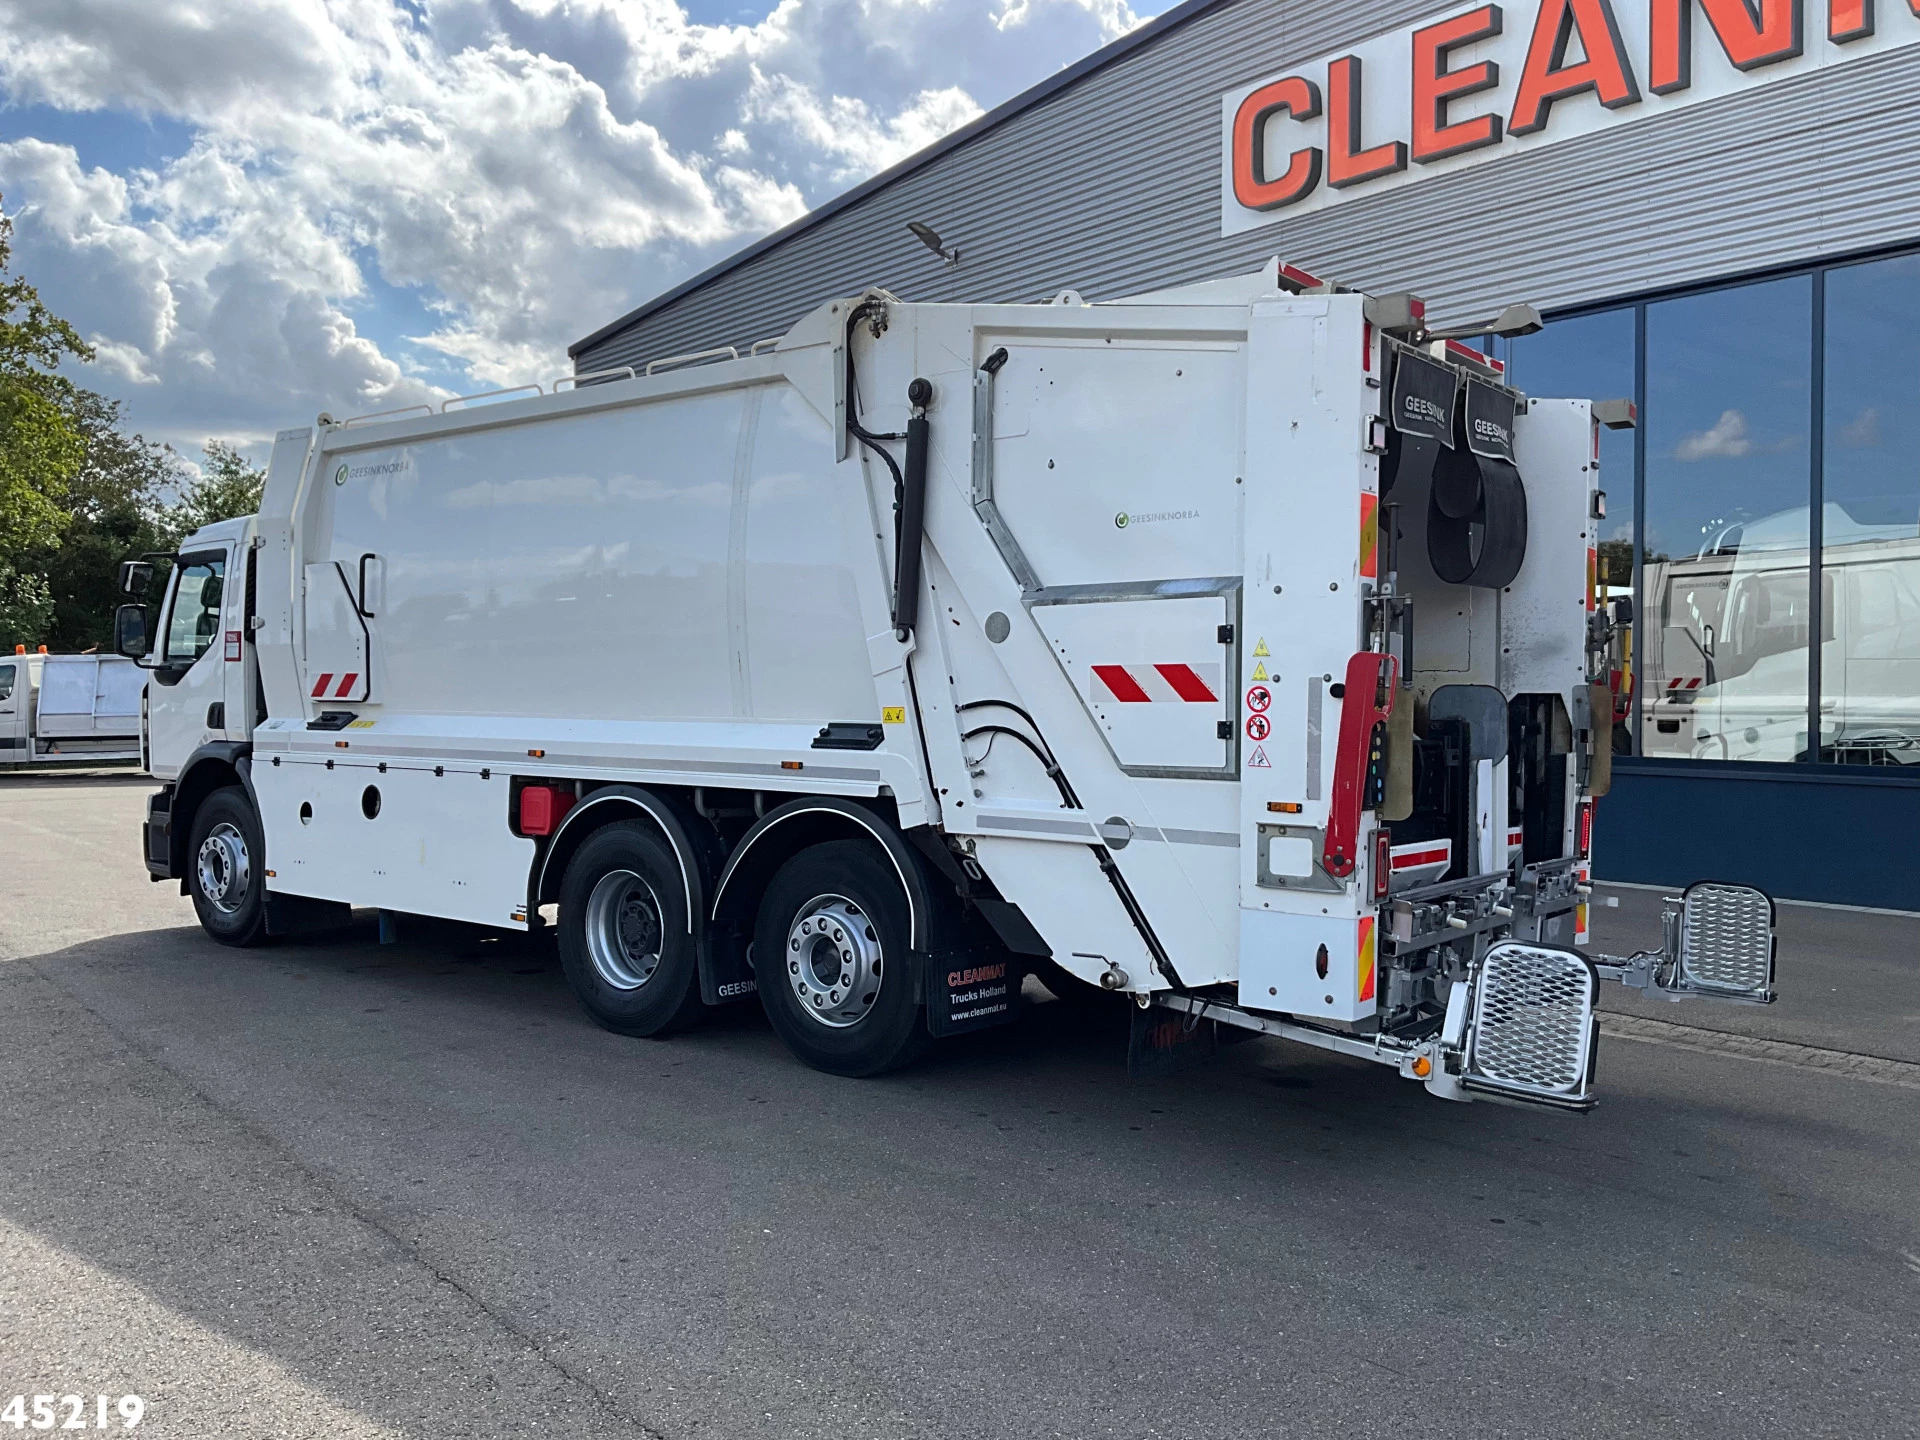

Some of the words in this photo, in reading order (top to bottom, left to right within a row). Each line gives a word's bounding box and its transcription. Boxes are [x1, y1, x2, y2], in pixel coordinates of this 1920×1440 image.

[1232, 0, 1920, 212] CLEAN
[1405, 395, 1445, 423] GEESINK
[1474, 418, 1508, 443] GEESINK
[349, 461, 409, 479] GEESINKNORBA
[1130, 509, 1200, 524] GEESINKNORBA
[948, 963, 1006, 987] CLEANMAT
[718, 980, 757, 997] GEESIN
[950, 991, 978, 1004] Trucks
[979, 984, 1006, 999] Holland
[950, 1003, 1007, 1021] www.cleanmat.eu
